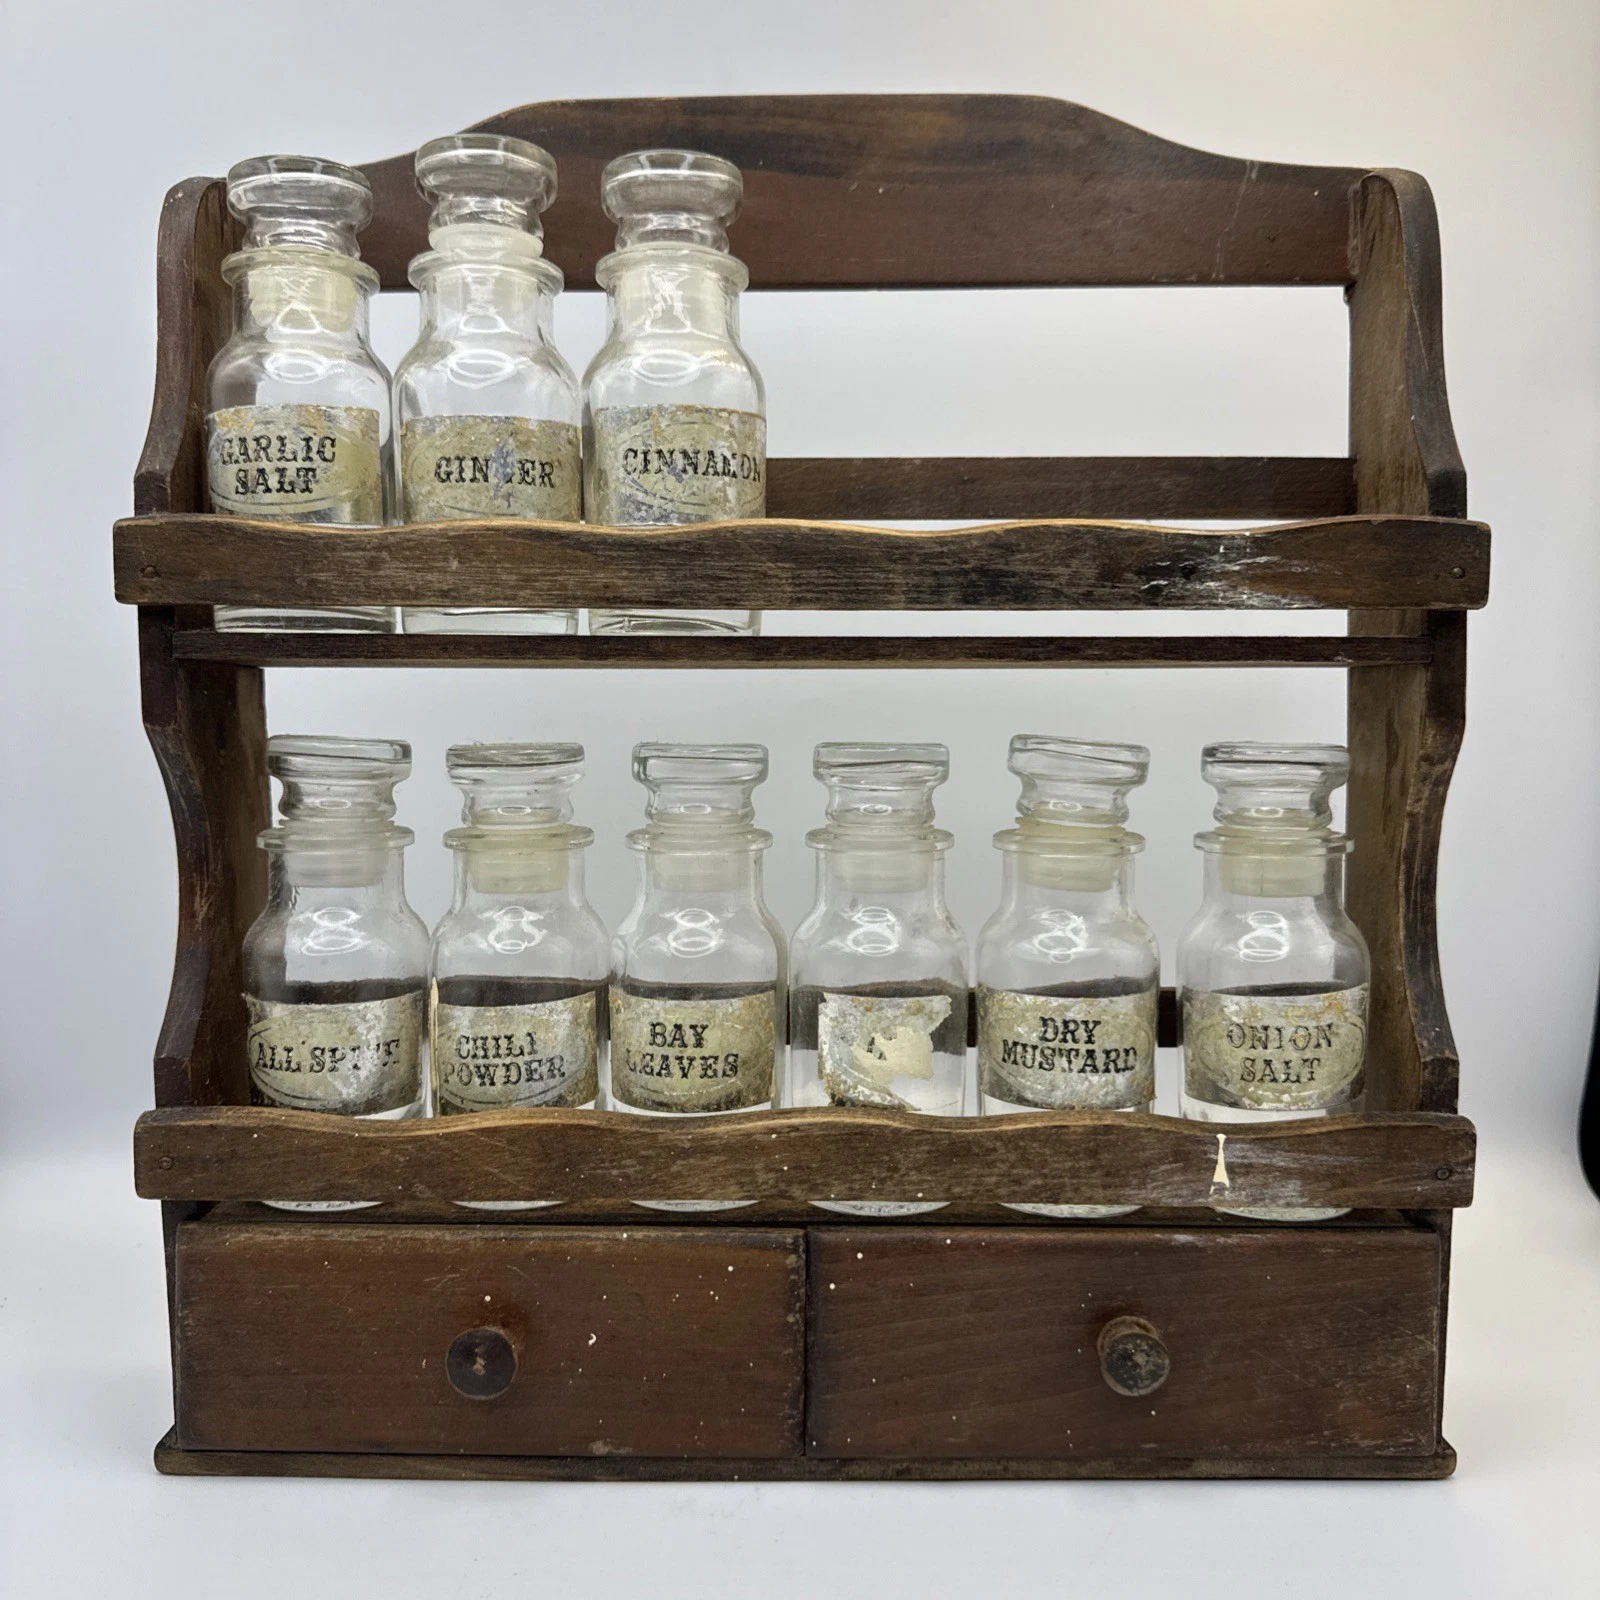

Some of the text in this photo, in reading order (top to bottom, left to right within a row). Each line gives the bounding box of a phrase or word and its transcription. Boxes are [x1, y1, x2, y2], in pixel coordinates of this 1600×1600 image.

[220, 435, 337, 465] GARLIC
[235, 467, 317, 495] SALT
[434, 455, 555, 489] GINER
[649, 1022, 709, 1049] BAY
[1039, 1016, 1101, 1045] DRY
[1226, 1022, 1334, 1051] ONION
[455, 1031, 538, 1060] CHILI
[1001, 1039, 1138, 1074] MUSTARD
[443, 1055, 566, 1087] POWDER
[1239, 1057, 1321, 1084] SALT
